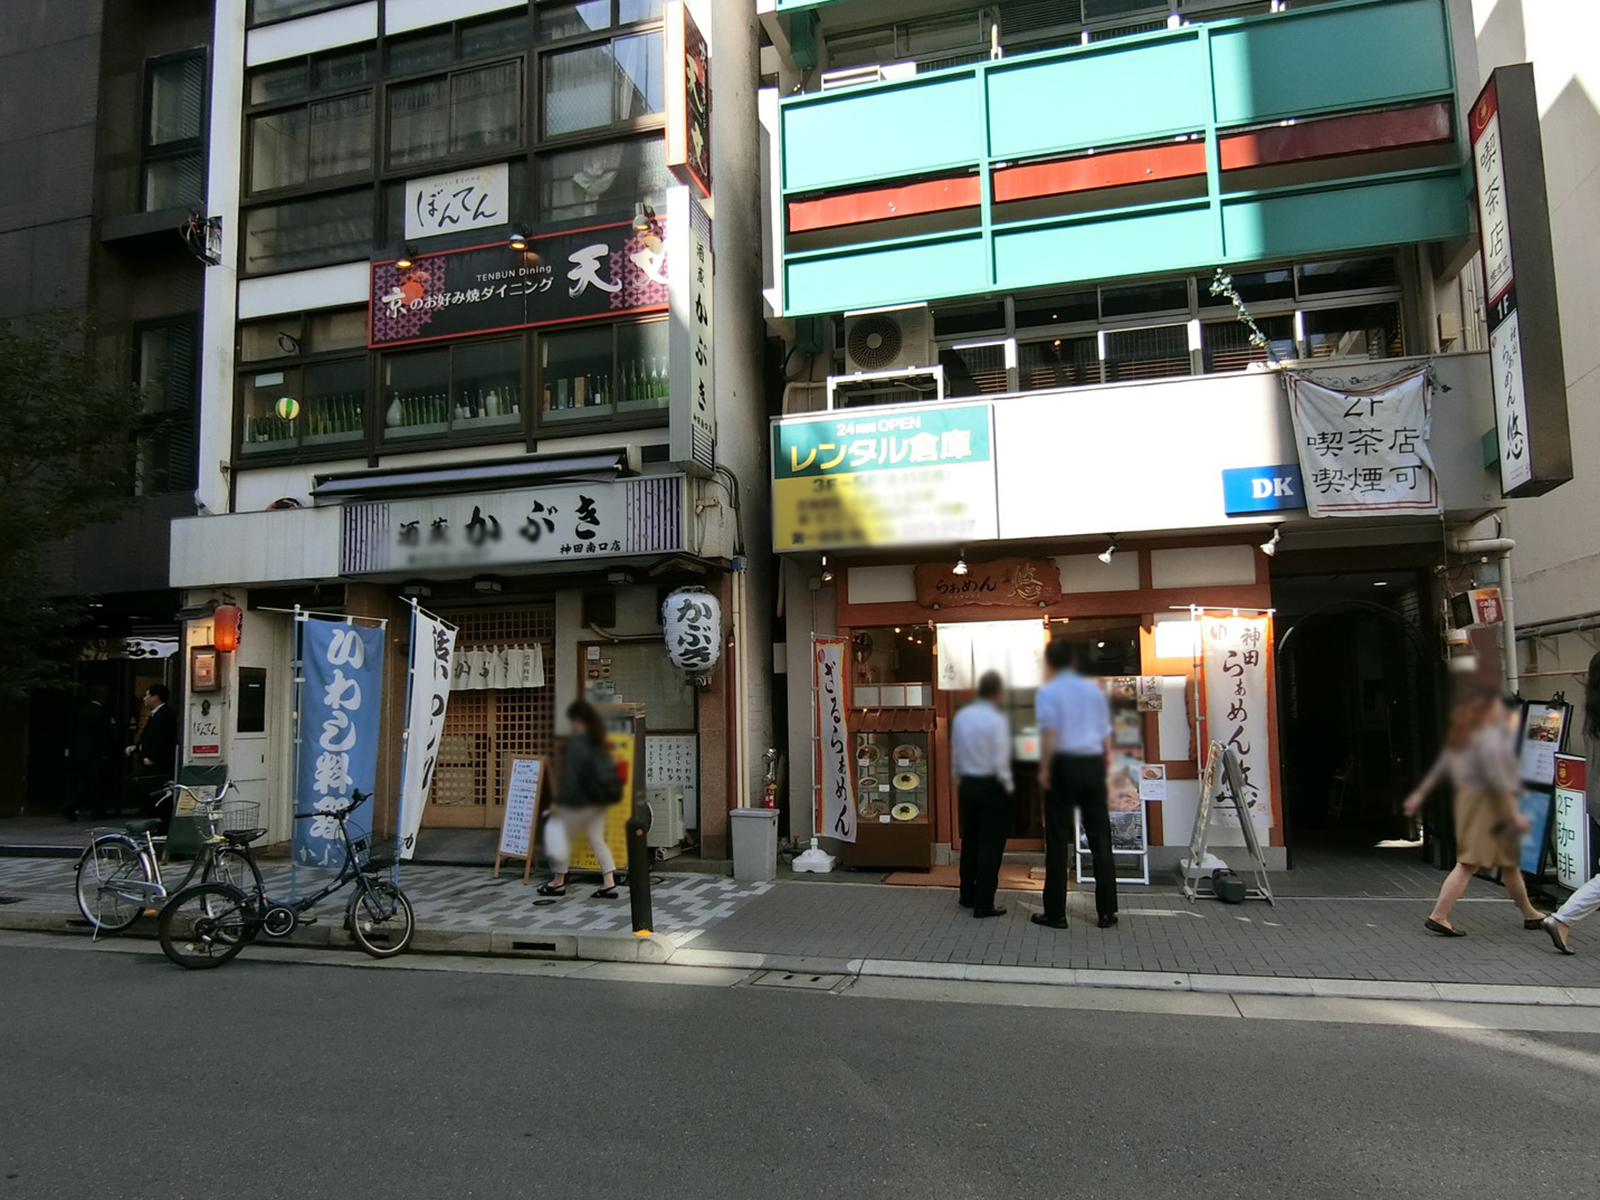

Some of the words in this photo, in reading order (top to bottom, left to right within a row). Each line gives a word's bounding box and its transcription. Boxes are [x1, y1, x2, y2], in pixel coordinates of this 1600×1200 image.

[417, 186, 498, 228] ぼんてん
[1479, 133, 1504, 258] 喫茶店
[476, 269, 516, 282] TENBUN
[518, 264, 552, 277] Dining
[1497, 293, 1509, 320] 1F
[694, 292, 708, 411] かぶき
[791, 429, 972, 472] レンタル倉庫
[1307, 427, 1420, 457] 喫茶店
[1251, 476, 1294, 499] DK
[1312, 465, 1423, 494] 喫煙可
[560, 540, 621, 554] 神田南口店
[936, 576, 997, 594] らぁめん
[676, 598, 713, 668] かぶき
[1241, 627, 1261, 667] 神田
[1223, 650, 1251, 755] らぁめん
[193, 721, 218, 736] ぼんてん
[1557, 794, 1573, 816] 2F
